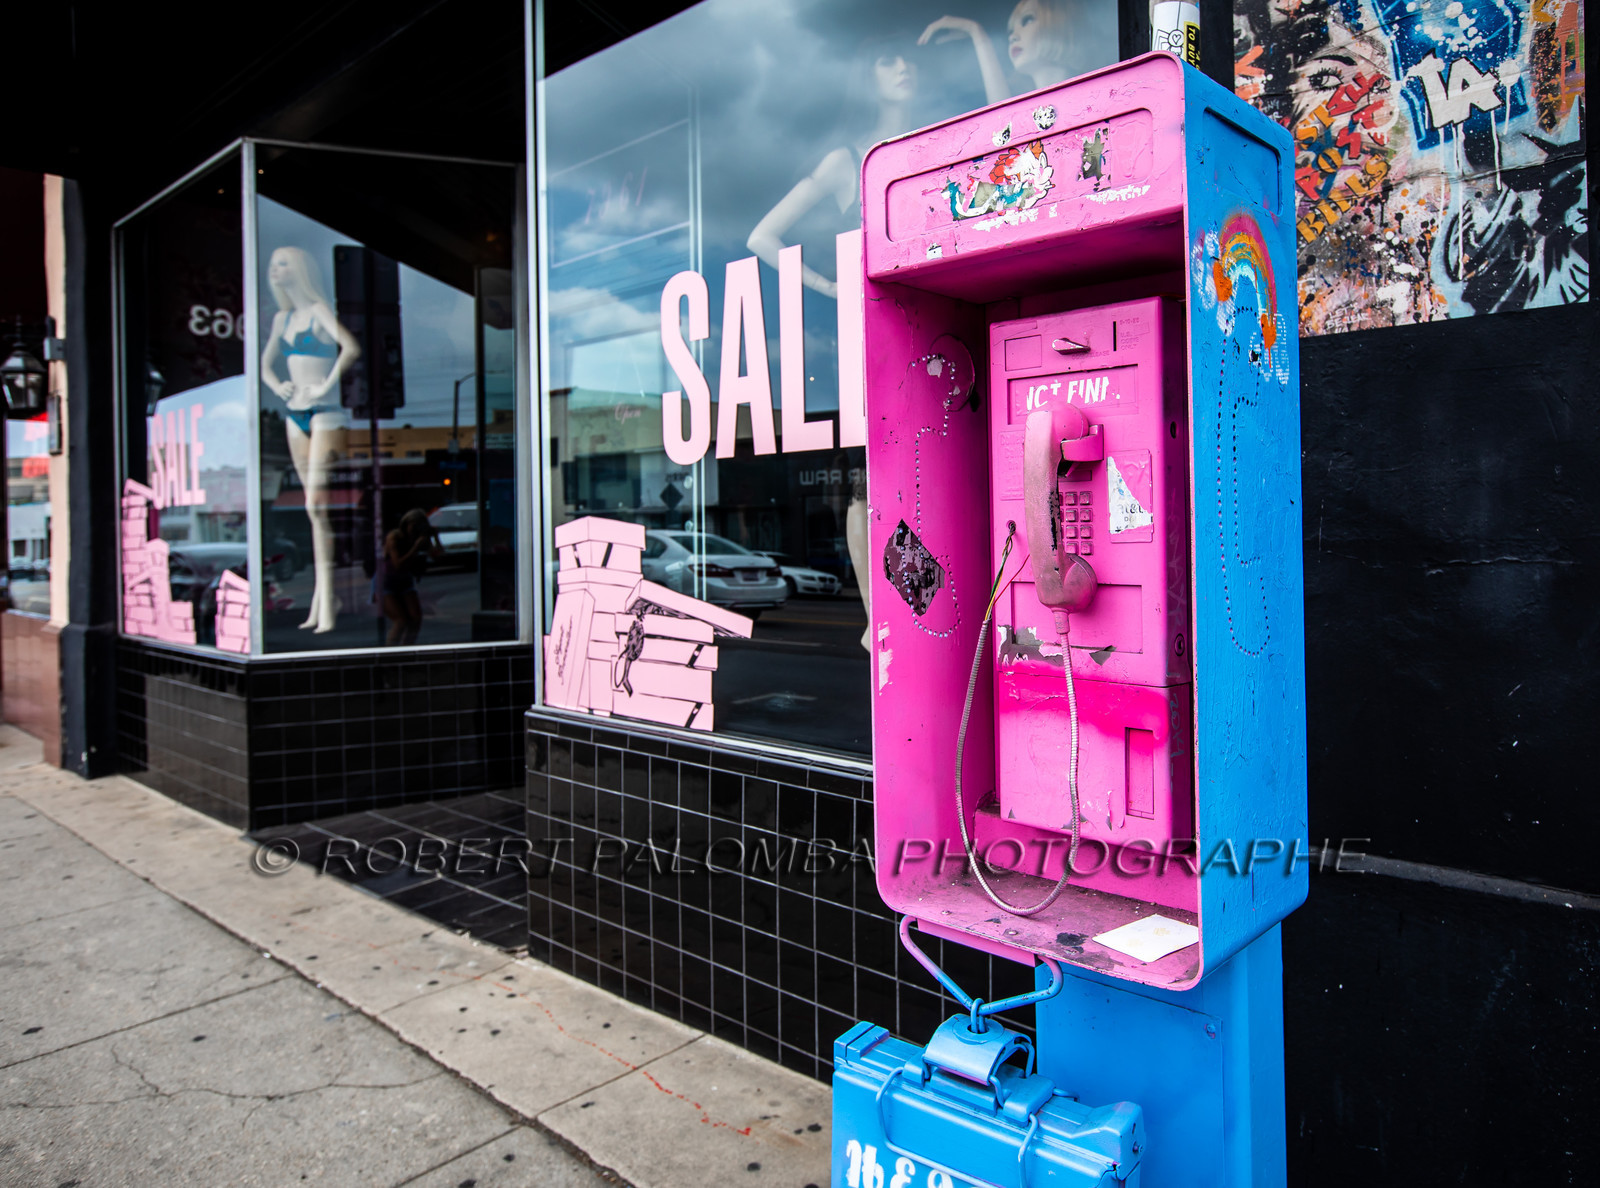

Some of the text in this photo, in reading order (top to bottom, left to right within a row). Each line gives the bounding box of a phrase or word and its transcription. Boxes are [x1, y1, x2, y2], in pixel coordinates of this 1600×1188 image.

[1188, 27, 1196, 66] TO BUY
[151, 402, 206, 510] SALE
